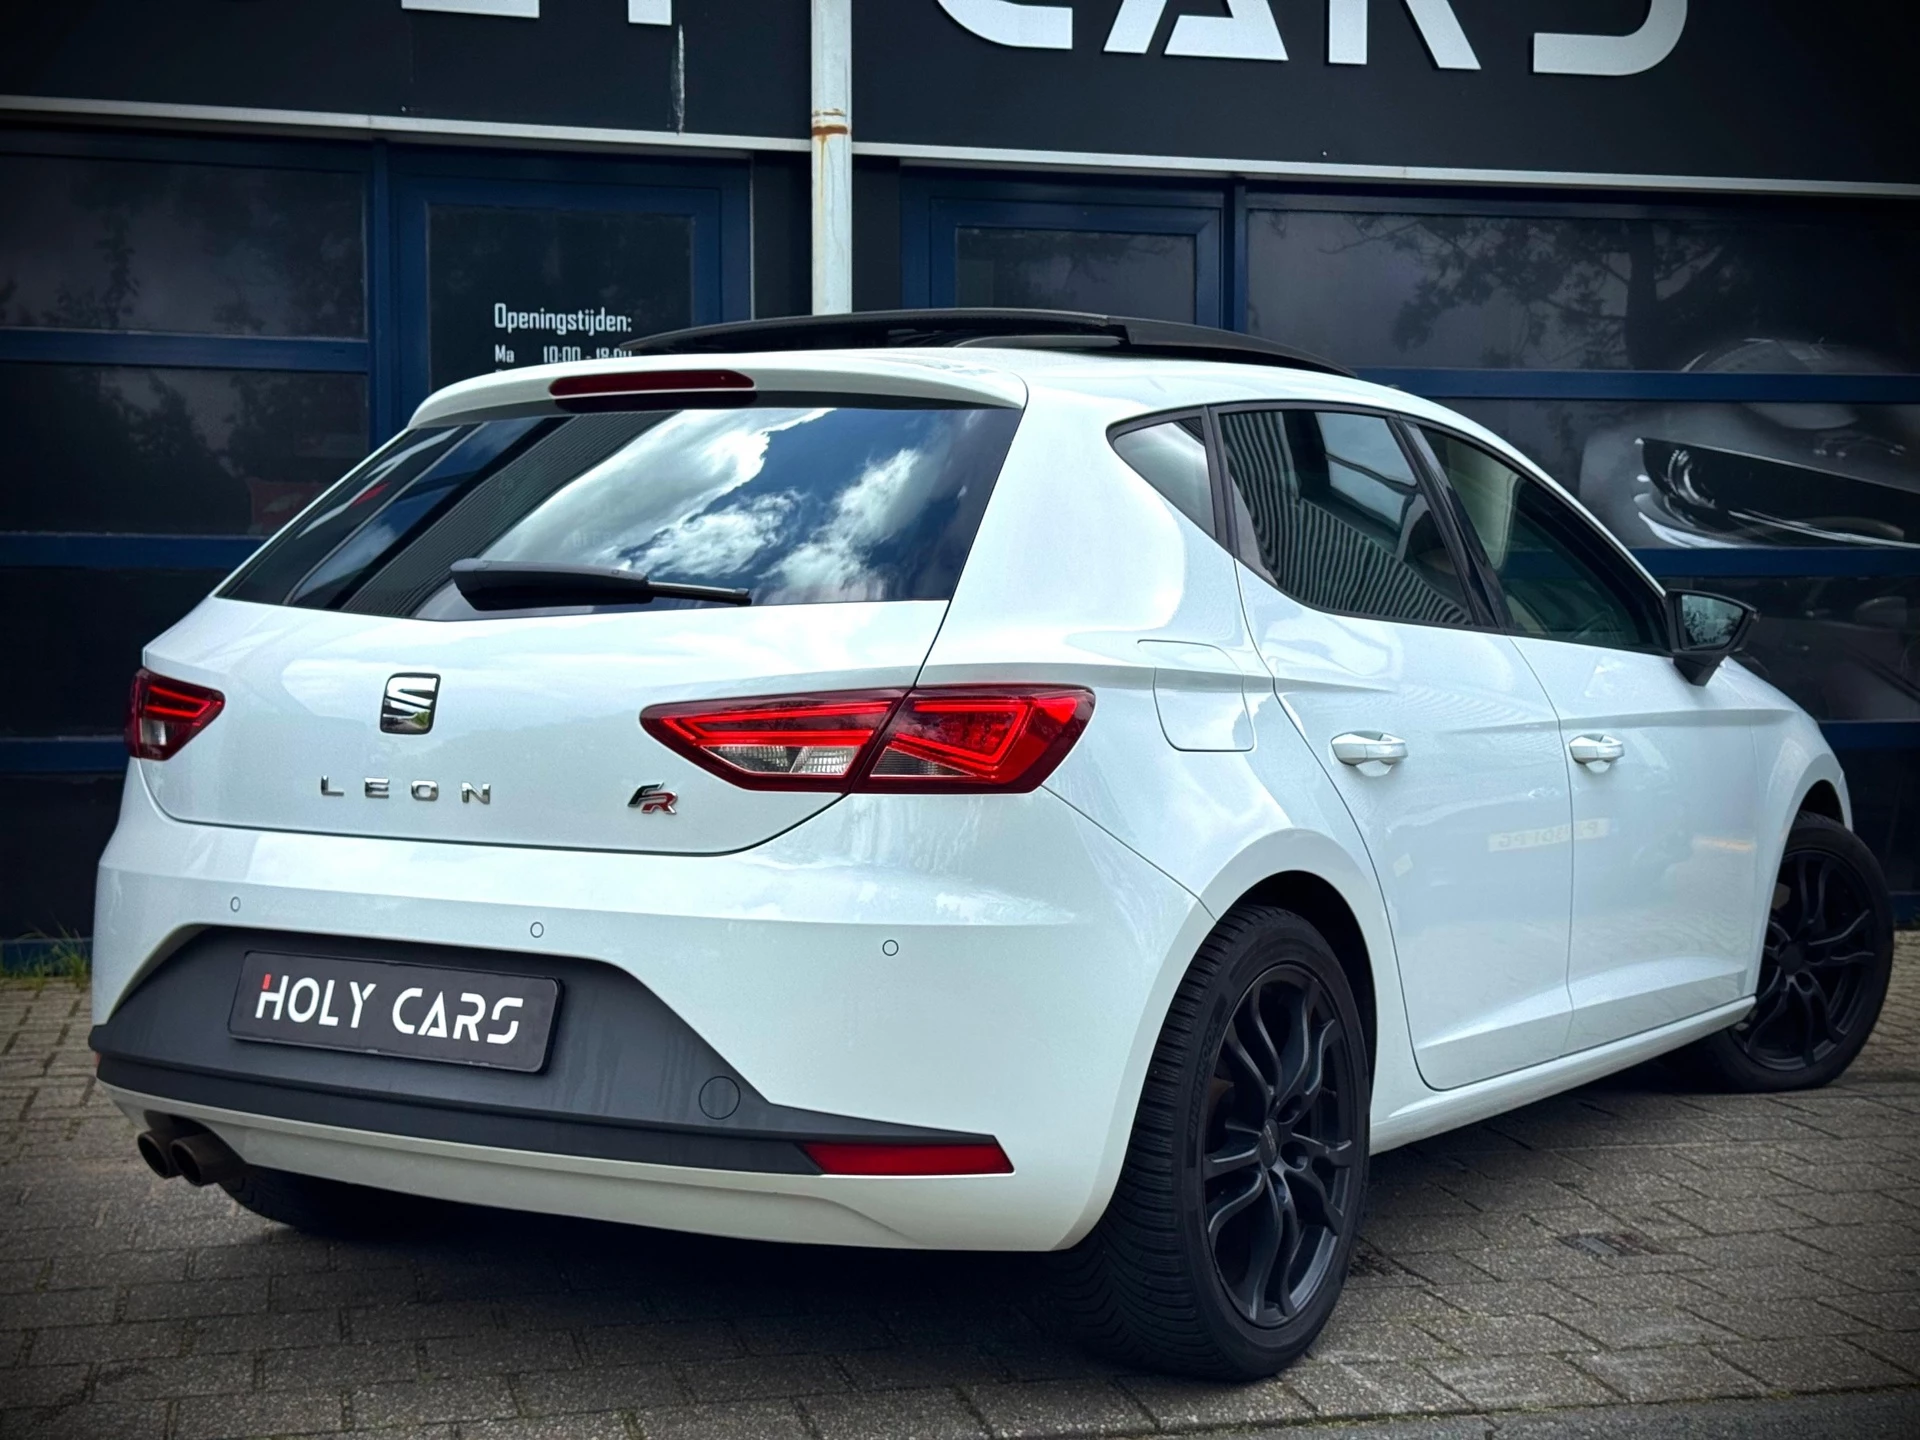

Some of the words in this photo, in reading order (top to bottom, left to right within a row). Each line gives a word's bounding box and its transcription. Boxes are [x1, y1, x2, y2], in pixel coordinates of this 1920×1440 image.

[494, 302, 632, 337] Openingstijden:
[494, 344, 515, 363] Ma
[543, 345, 581, 364] 10:00
[320, 775, 491, 805] LEON
[627, 781, 679, 816] FR
[254, 973, 377, 1029] HOLY
[391, 987, 525, 1045] CARS
